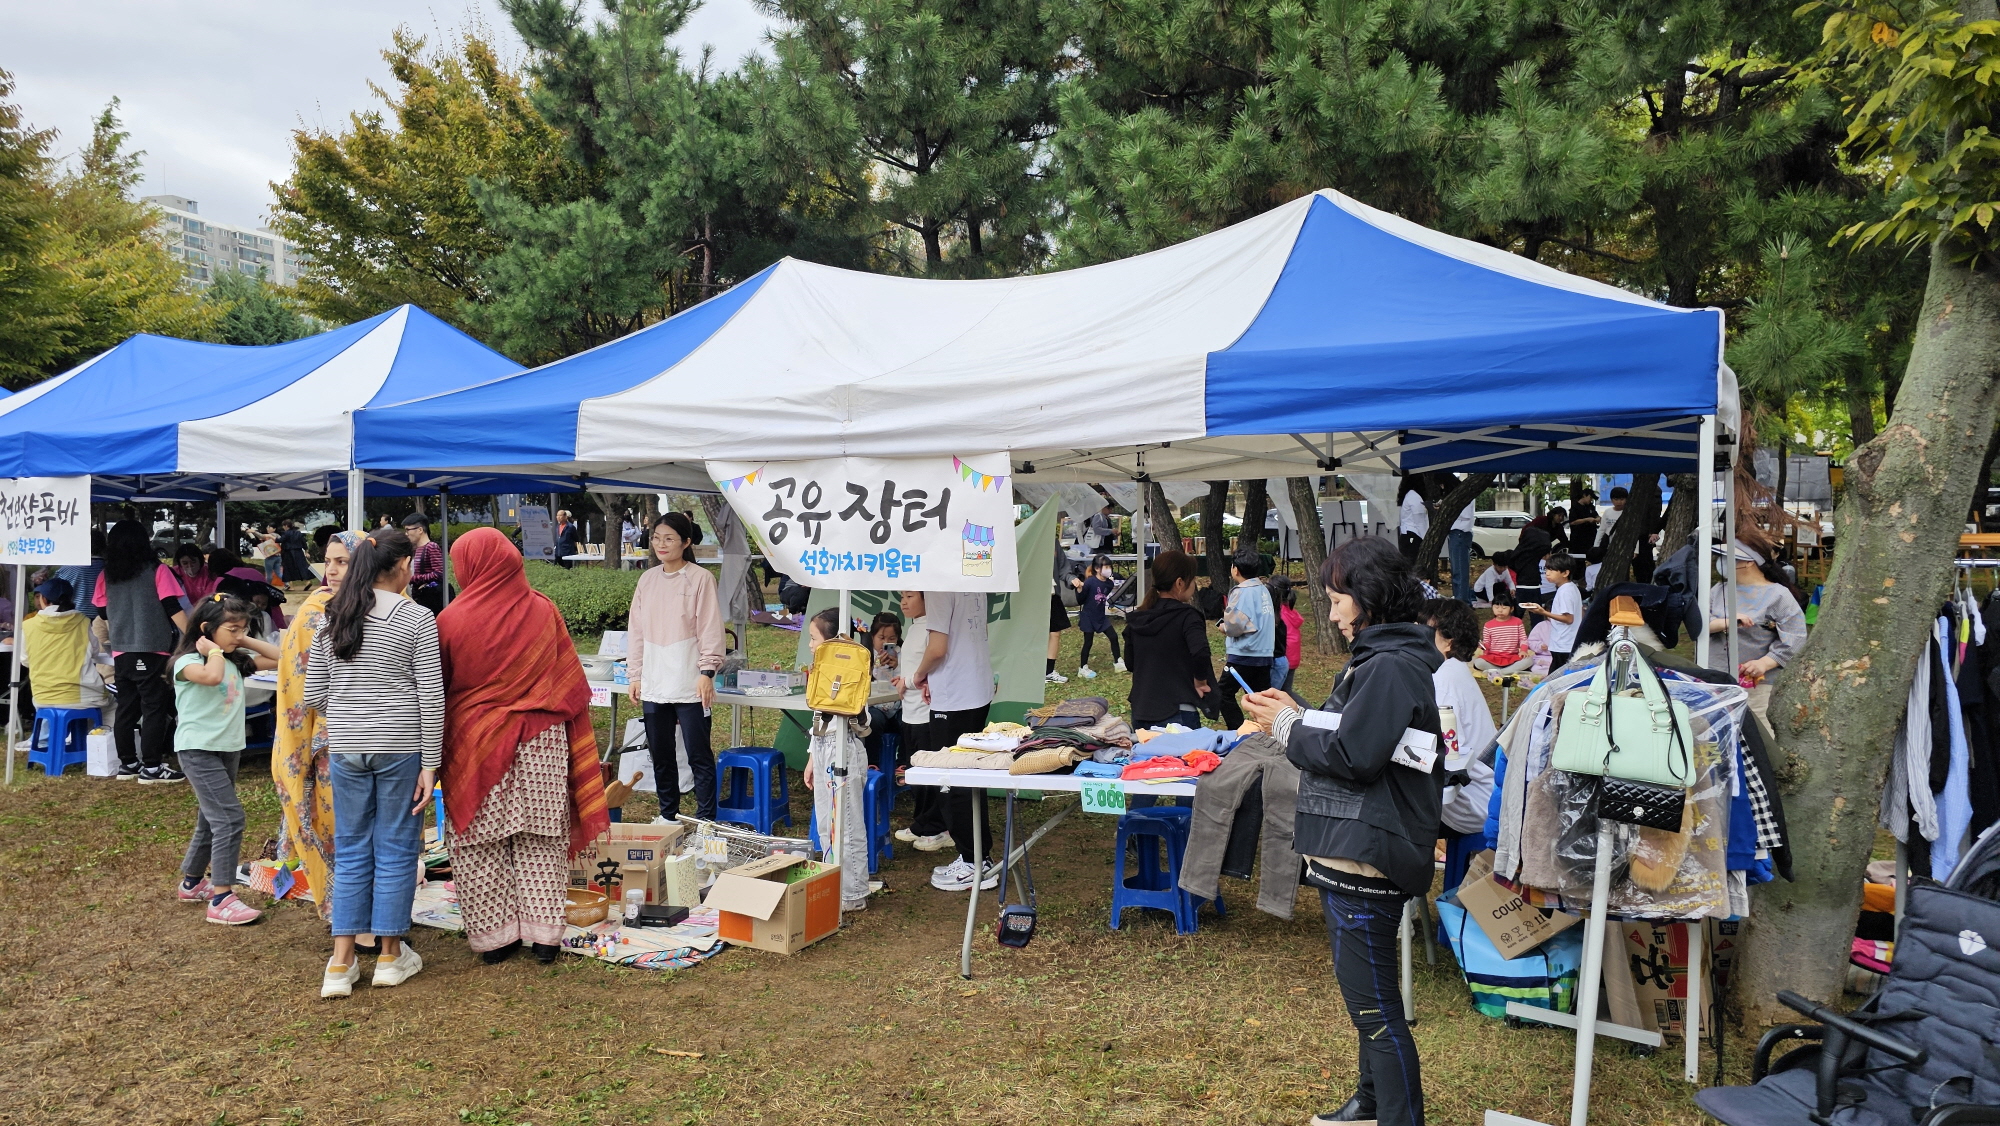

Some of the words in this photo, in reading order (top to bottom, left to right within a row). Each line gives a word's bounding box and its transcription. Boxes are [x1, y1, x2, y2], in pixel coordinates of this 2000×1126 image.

[762, 477, 832, 546] 공유
[838, 480, 952, 545] 장터
[799, 547, 921, 578] 석호가치키움터
[629, 850, 652, 859] 멀티팩
[1339, 881, 1356, 891] Milan
[1358, 886, 1387, 895] Collection
[219, 908, 233, 919] N
[1492, 895, 1524, 920] coup
